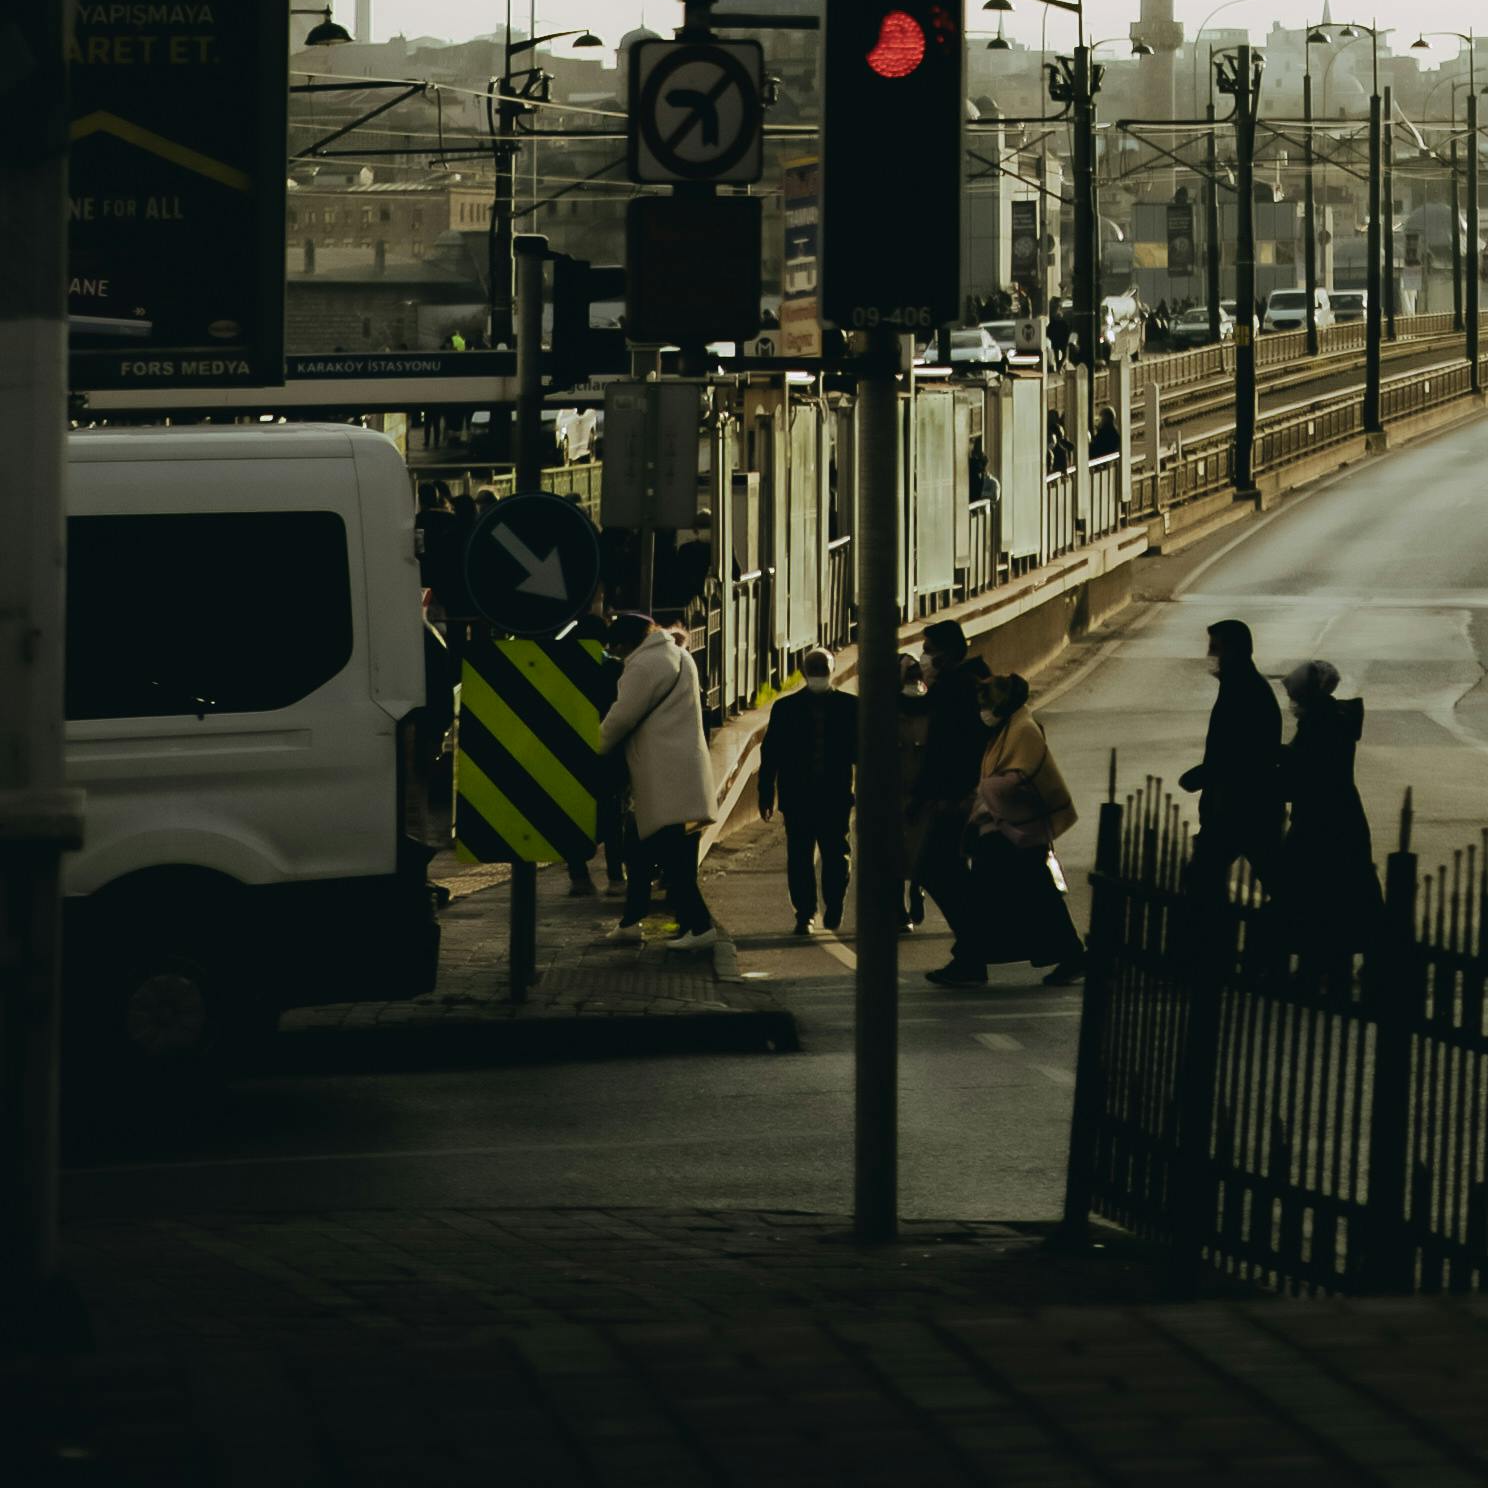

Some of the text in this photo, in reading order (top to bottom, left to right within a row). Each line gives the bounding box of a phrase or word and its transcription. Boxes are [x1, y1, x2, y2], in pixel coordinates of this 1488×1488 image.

[80, 4, 215, 32] YAPIŞMAYA
[64, 35, 159, 64] ARET
[68, 197, 185, 221] NE FOR ALL
[69, 278, 111, 297] ANE
[852, 306, 932, 327] 09-406
[121, 360, 250, 376] FORS MEDYA
[297, 359, 442, 373] KARAKÖY İSTASYONU
